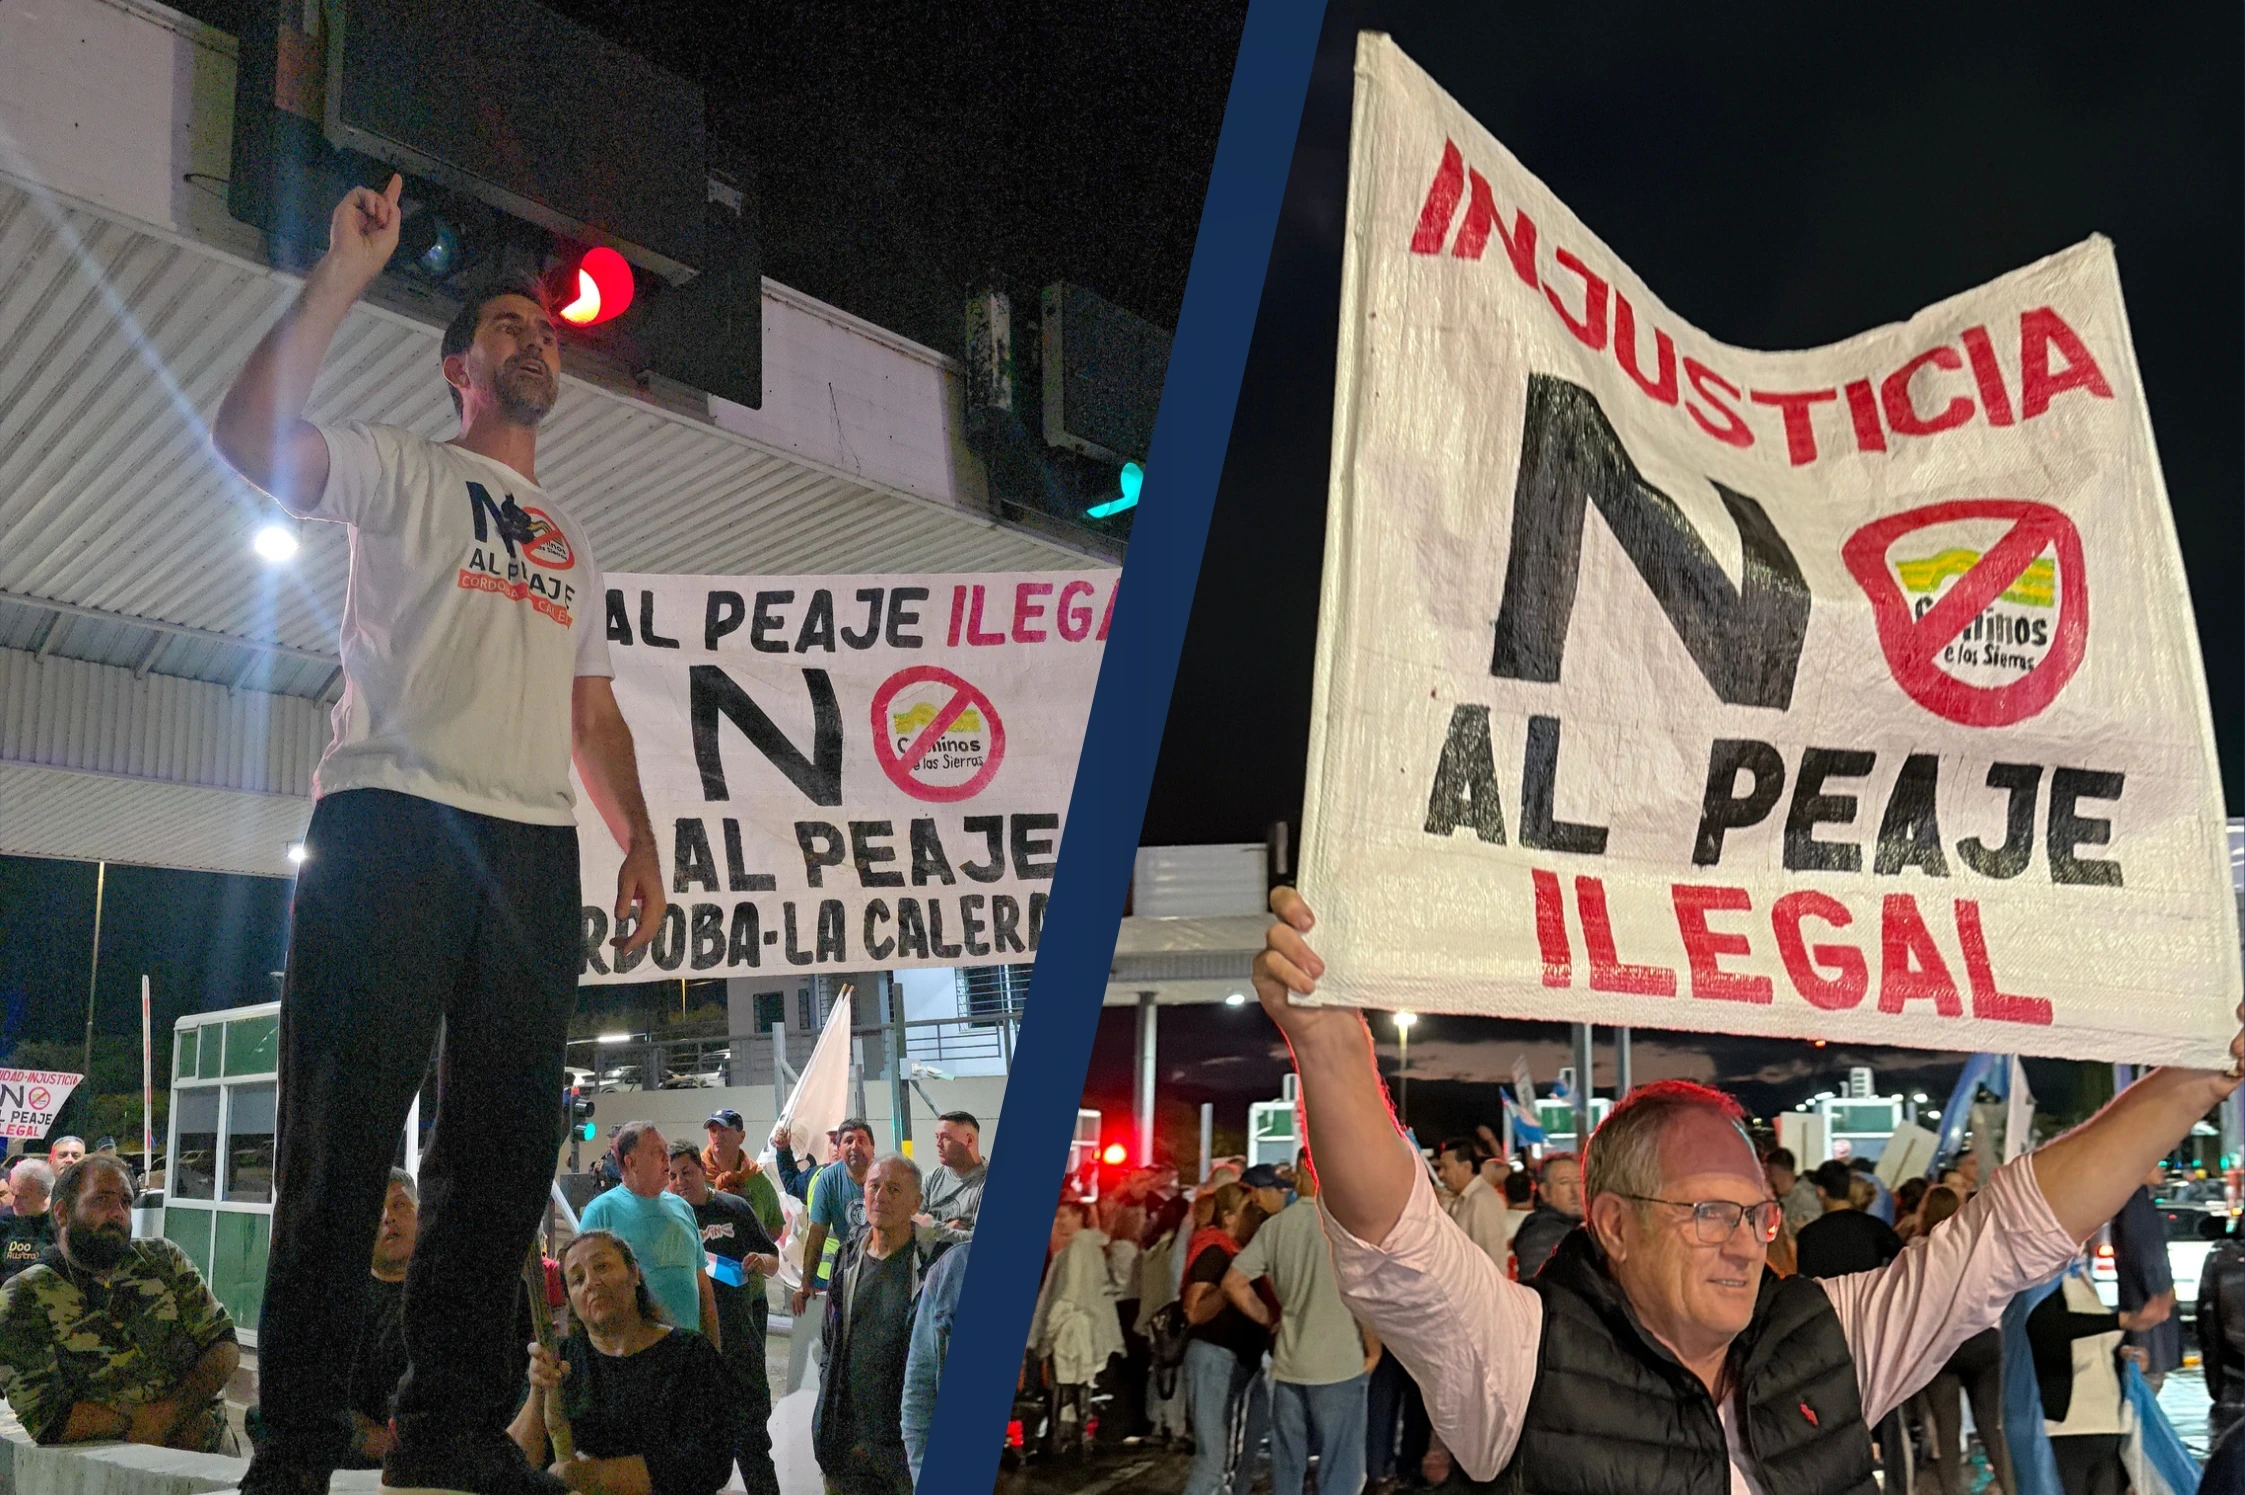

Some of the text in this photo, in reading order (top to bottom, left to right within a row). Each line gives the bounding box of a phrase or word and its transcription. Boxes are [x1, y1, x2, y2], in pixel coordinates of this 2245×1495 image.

[1410, 136, 2114, 466] INJUSTICIA
[468, 547, 501, 576] AL
[605, 588, 680, 649] AL
[705, 587, 930, 654] PEAJE
[897, 735, 982, 754] Cminos
[923, 757, 940, 770] las
[942, 753, 985, 770] Sierras
[1424, 704, 2125, 887] AL PEAJE
[673, 812, 1060, 894] AL PEAJE
[1531, 868, 2054, 1027] ILEGAL
[11, 1111, 52, 1125] PEAJE
